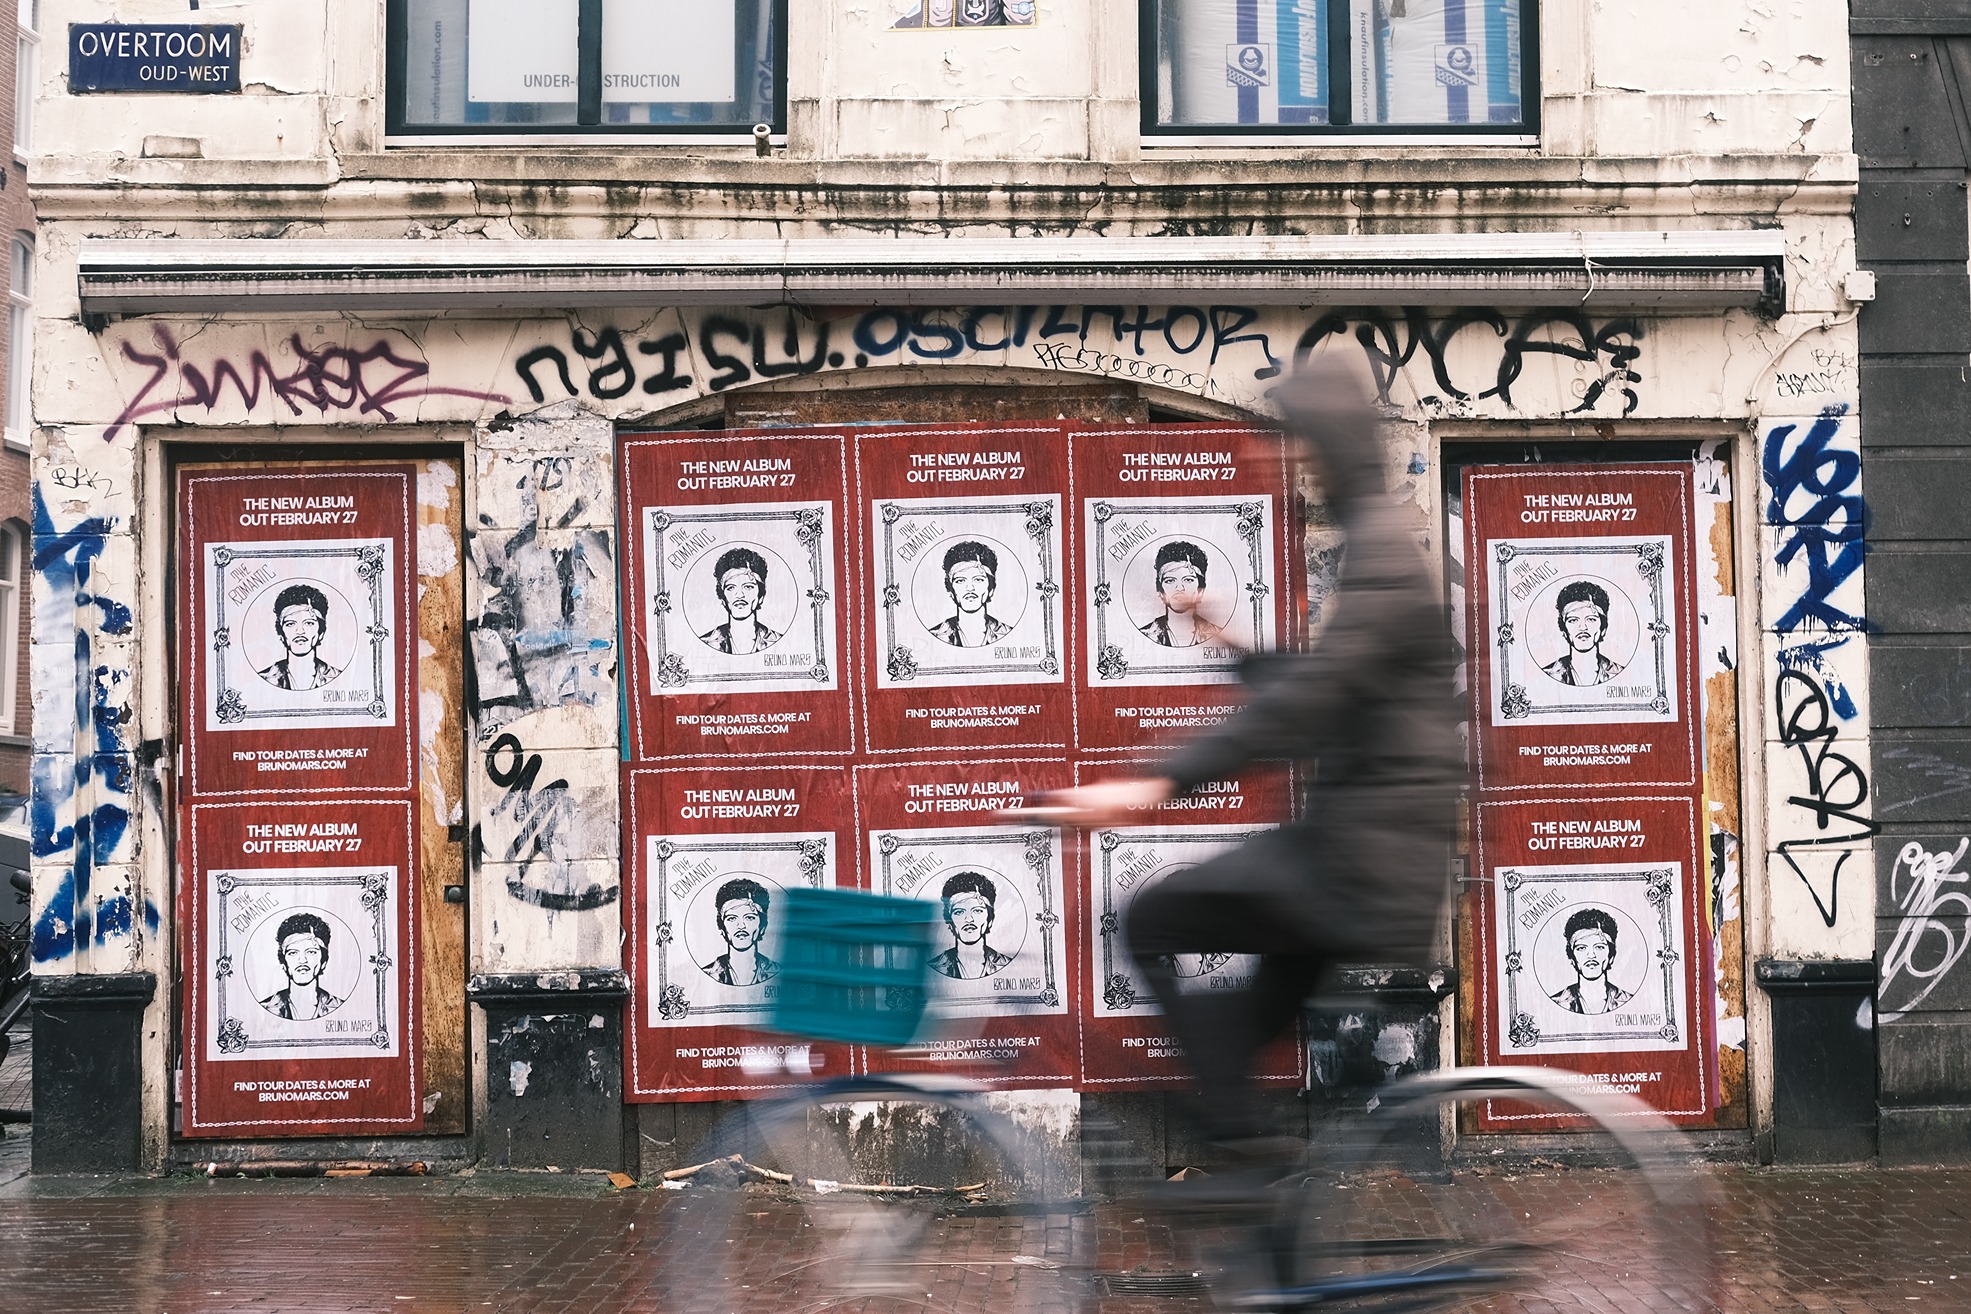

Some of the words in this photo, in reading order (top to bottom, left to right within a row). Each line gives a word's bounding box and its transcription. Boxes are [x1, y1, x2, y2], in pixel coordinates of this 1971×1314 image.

[78, 31, 231, 58] OVERTOOM
[139, 65, 230, 82] OUD-WEST
[680, 461, 707, 474] THE
[708, 459, 741, 473] NEW
[742, 458, 791, 472] ALBUM
[909, 453, 936, 467] THE
[937, 452, 970, 466] NEW
[971, 451, 1020, 465] ALBUM
[1122, 453, 1149, 466] THE
[1149, 452, 1182, 466] NEW
[1183, 452, 1231, 465] ALBUM
[677, 476, 707, 490] OUT
[707, 474, 778, 489] FEBRUARY
[780, 473, 795, 486] 27
[906, 469, 936, 483] OUT
[937, 467, 1008, 482] FEBRUARY
[1009, 466, 1025, 479] 27
[1119, 468, 1148, 482] OUT
[1149, 467, 1219, 482] FEBRUARY
[1220, 467, 1236, 480] 27
[242, 497, 269, 510] THE
[270, 496, 303, 510] NEW
[305, 495, 353, 509] ALBUM
[1523, 494, 1549, 507] THE
[1550, 493, 1583, 507] NEW
[1584, 492, 1632, 506] ALBUM
[239, 513, 269, 526] OUT
[270, 511, 341, 525] FEBRUARY
[342, 510, 358, 523] 27
[1520, 510, 1549, 523] OUT
[1551, 508, 1620, 523] FEBRUARY
[1621, 508, 1637, 521] 27
[669, 526, 689, 546] THE
[898, 519, 919, 539] THE
[1110, 518, 1131, 538] THE
[896, 521, 945, 563] ROMANTIC
[1108, 520, 1157, 562] ROMANTIC
[667, 528, 717, 571] ROMANTIC
[230, 562, 250, 582] THE
[1512, 559, 1533, 578] THE
[227, 564, 277, 606] ROMANTIC
[1510, 561, 1559, 602] ROMANTIC
[676, 715, 698, 724] FIND
[698, 714, 726, 724] TOUR
[726, 713, 757, 724] DATES
[758, 713, 767, 723] &
[768, 712, 796, 722] MORE
[797, 712, 811, 721] AT
[905, 708, 927, 718] FIND
[928, 707, 956, 717] TOUR
[957, 706, 988, 716] DATES
[989, 705, 997, 715] &
[998, 705, 1026, 715] MORE
[1027, 704, 1041, 714] AT
[1114, 707, 1137, 717] FIND
[1137, 706, 1165, 717] TOUR
[1165, 706, 1196, 716] DATES
[1197, 706, 1206, 715] &
[1207, 704, 1235, 715] MORE
[700, 724, 788, 736] BRUNOMARS.COM
[931, 716, 1018, 728] BRUNOMARS.COM
[232, 751, 255, 761] FIND
[256, 750, 284, 760] TOUR
[284, 749, 315, 759] DATES
[316, 749, 325, 758] &
[325, 748, 353, 758] MORE
[354, 748, 368, 757] AT
[1518, 746, 1541, 755] FIND
[1541, 745, 1569, 755] TOUR
[1569, 744, 1600, 754] DATES
[1600, 744, 1609, 754] &
[1610, 743, 1638, 753] MORE
[1638, 743, 1652, 753] AT
[257, 759, 346, 771] BRUNOMARS.COM
[1543, 754, 1631, 766] BRUNOMARS.COM
[907, 784, 934, 797] THE
[935, 783, 968, 796] NEW
[970, 781, 1019, 795] ALBUM
[1190, 780, 1239, 794] ALBUM
[684, 790, 710, 803] THE
[711, 789, 743, 802] NEW
[746, 788, 794, 801] ALBUM
[1228, 795, 1244, 809] 27
[680, 805, 710, 819] OUT
[711, 804, 781, 818] FEBRUARY
[784, 804, 799, 817] 27
[904, 800, 934, 813] OUT
[935, 797, 1007, 812] FEBRUARY
[246, 824, 272, 837] THE
[274, 824, 307, 837] NEW
[308, 822, 357, 836] ALBUM
[1530, 821, 1557, 834] THE
[1558, 820, 1591, 834] NEW
[1592, 819, 1641, 833] ALBUM
[242, 840, 272, 853] OUT
[273, 838, 344, 853] FEBRUARY
[346, 838, 362, 851] 27
[1527, 837, 1557, 850] OUT
[1559, 835, 1628, 850] FEBRUARY
[1630, 834, 1645, 847] 27
[896, 850, 917, 870] THE
[1117, 847, 1137, 867] THE
[671, 856, 692, 876] THE
[894, 852, 944, 894] ROMANTIC
[669, 858, 719, 900] ROMANTIC
[232, 890, 253, 910] THE
[1520, 886, 1540, 906] THE
[229, 892, 279, 934] ROMANTIC
[1518, 889, 1567, 930] ROMANTIC
[927, 1040, 955, 1050] TOUR
[956, 1038, 988, 1048] DATES
[988, 1038, 997, 1047] &
[997, 1037, 1026, 1047] MORE
[1027, 1036, 1041, 1046] AT
[1122, 1037, 1144, 1047] FIND
[676, 1048, 698, 1058] FIND
[701, 1047, 726, 1058] TOUR
[726, 1045, 757, 1056] DATES
[767, 1044, 795, 1055] MORE
[929, 1049, 1019, 1061] BRUNOMARS.COM
[233, 1081, 256, 1091] FIND
[257, 1080, 285, 1091] TOUR
[286, 1079, 317, 1090] DATES
[318, 1079, 327, 1089] &
[328, 1079, 356, 1089] MORE
[357, 1078, 371, 1088] AT
[1579, 1073, 1610, 1084] DATES
[1610, 1073, 1619, 1083] &
[1619, 1072, 1647, 1082] MORE
[1648, 1072, 1662, 1081] AT
[258, 1090, 348, 1102] BRUNOMARS.COM
